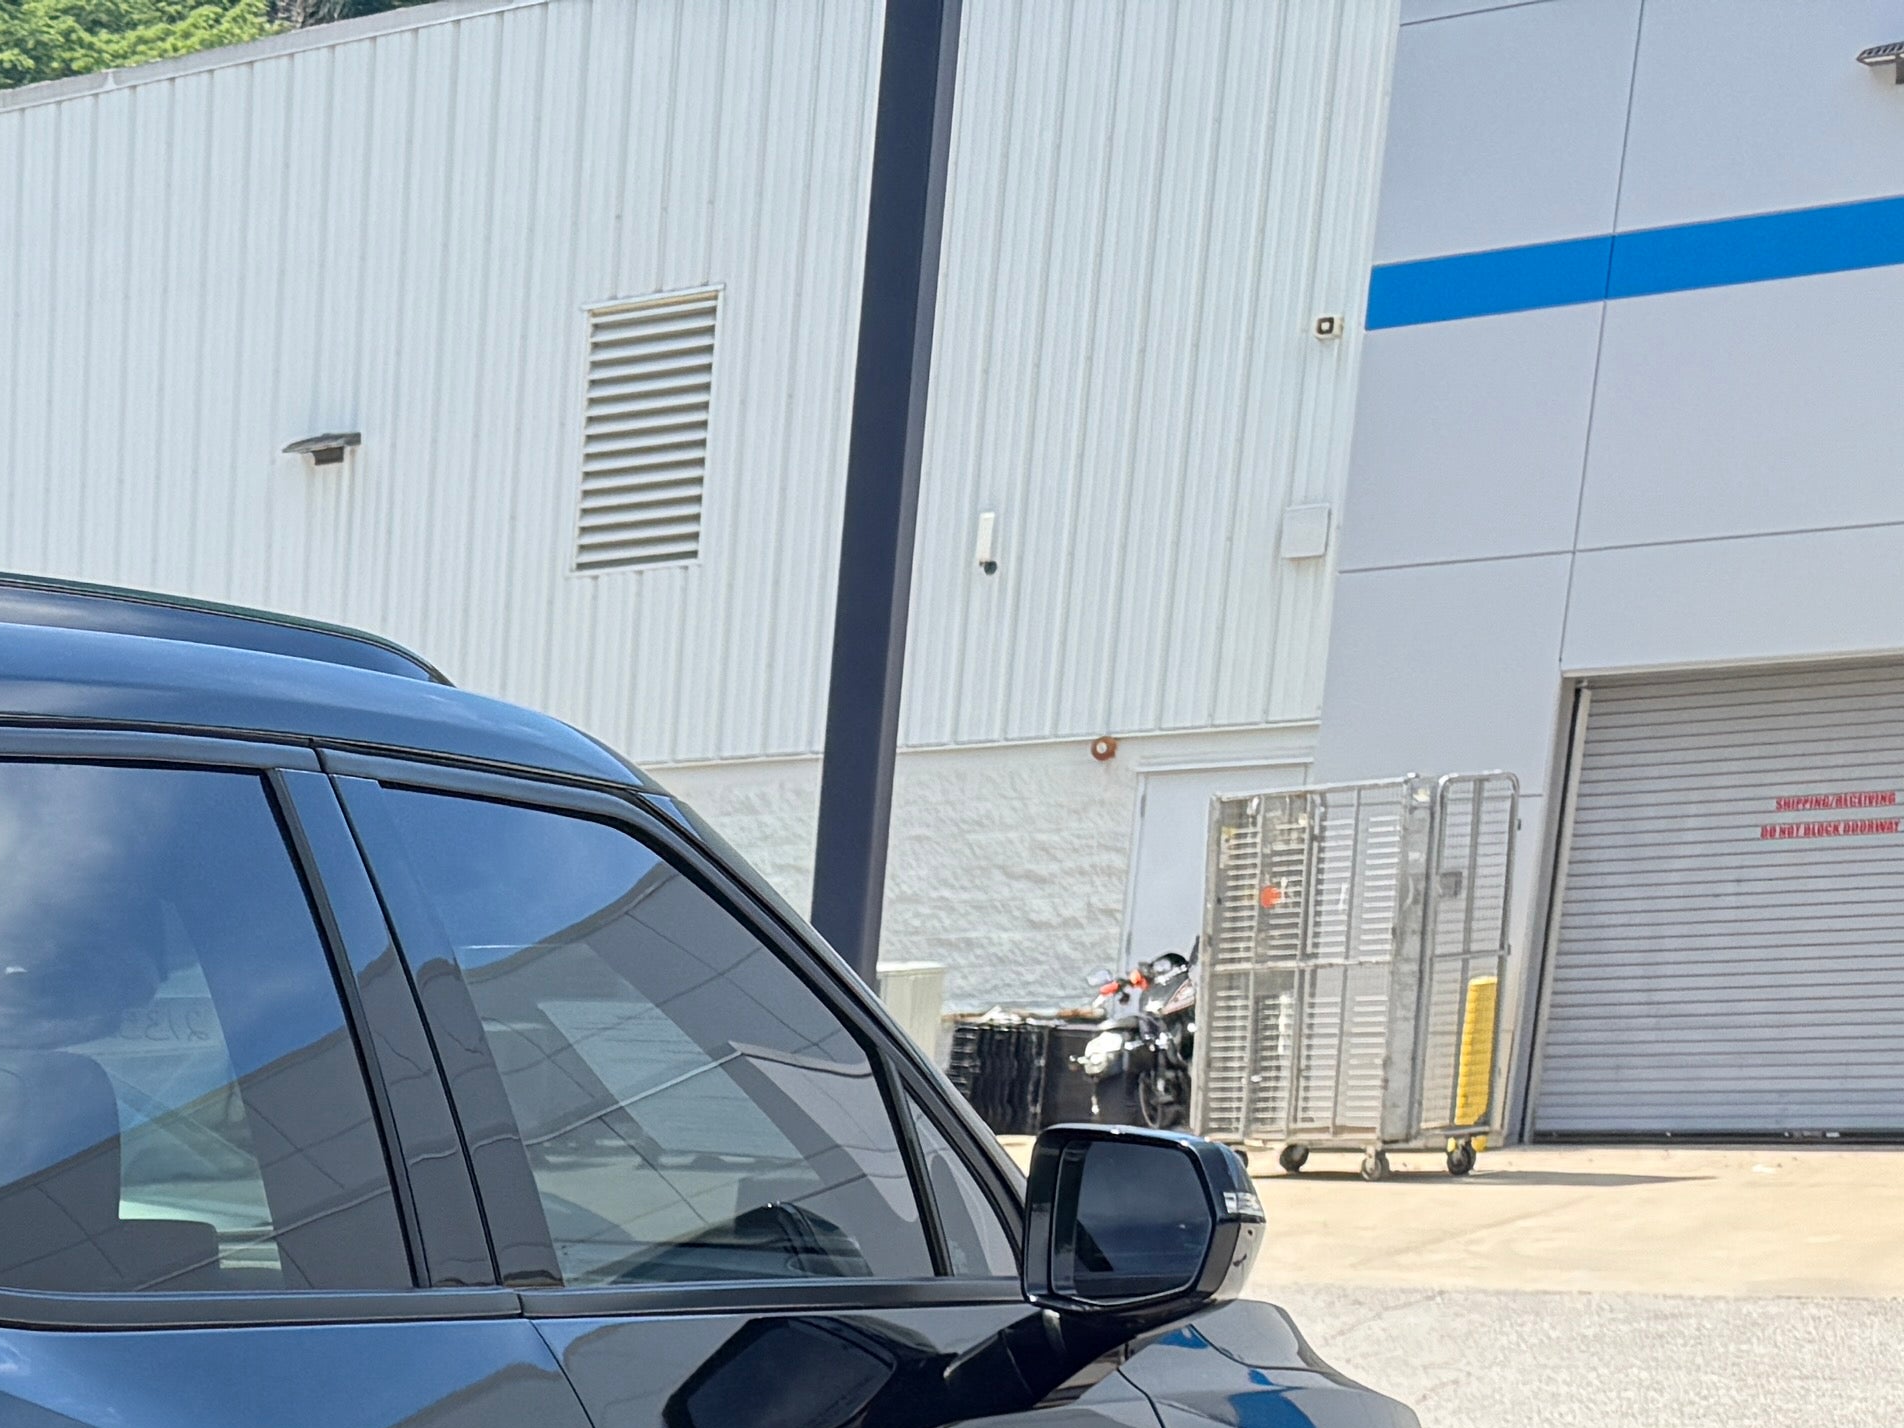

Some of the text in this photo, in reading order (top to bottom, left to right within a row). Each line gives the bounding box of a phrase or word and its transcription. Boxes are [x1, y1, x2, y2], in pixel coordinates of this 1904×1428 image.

[1775, 791, 1896, 812] SHIPPING/RECEIVING
[1760, 819, 1900, 840] DO NOT BLOCK DOORWAY
